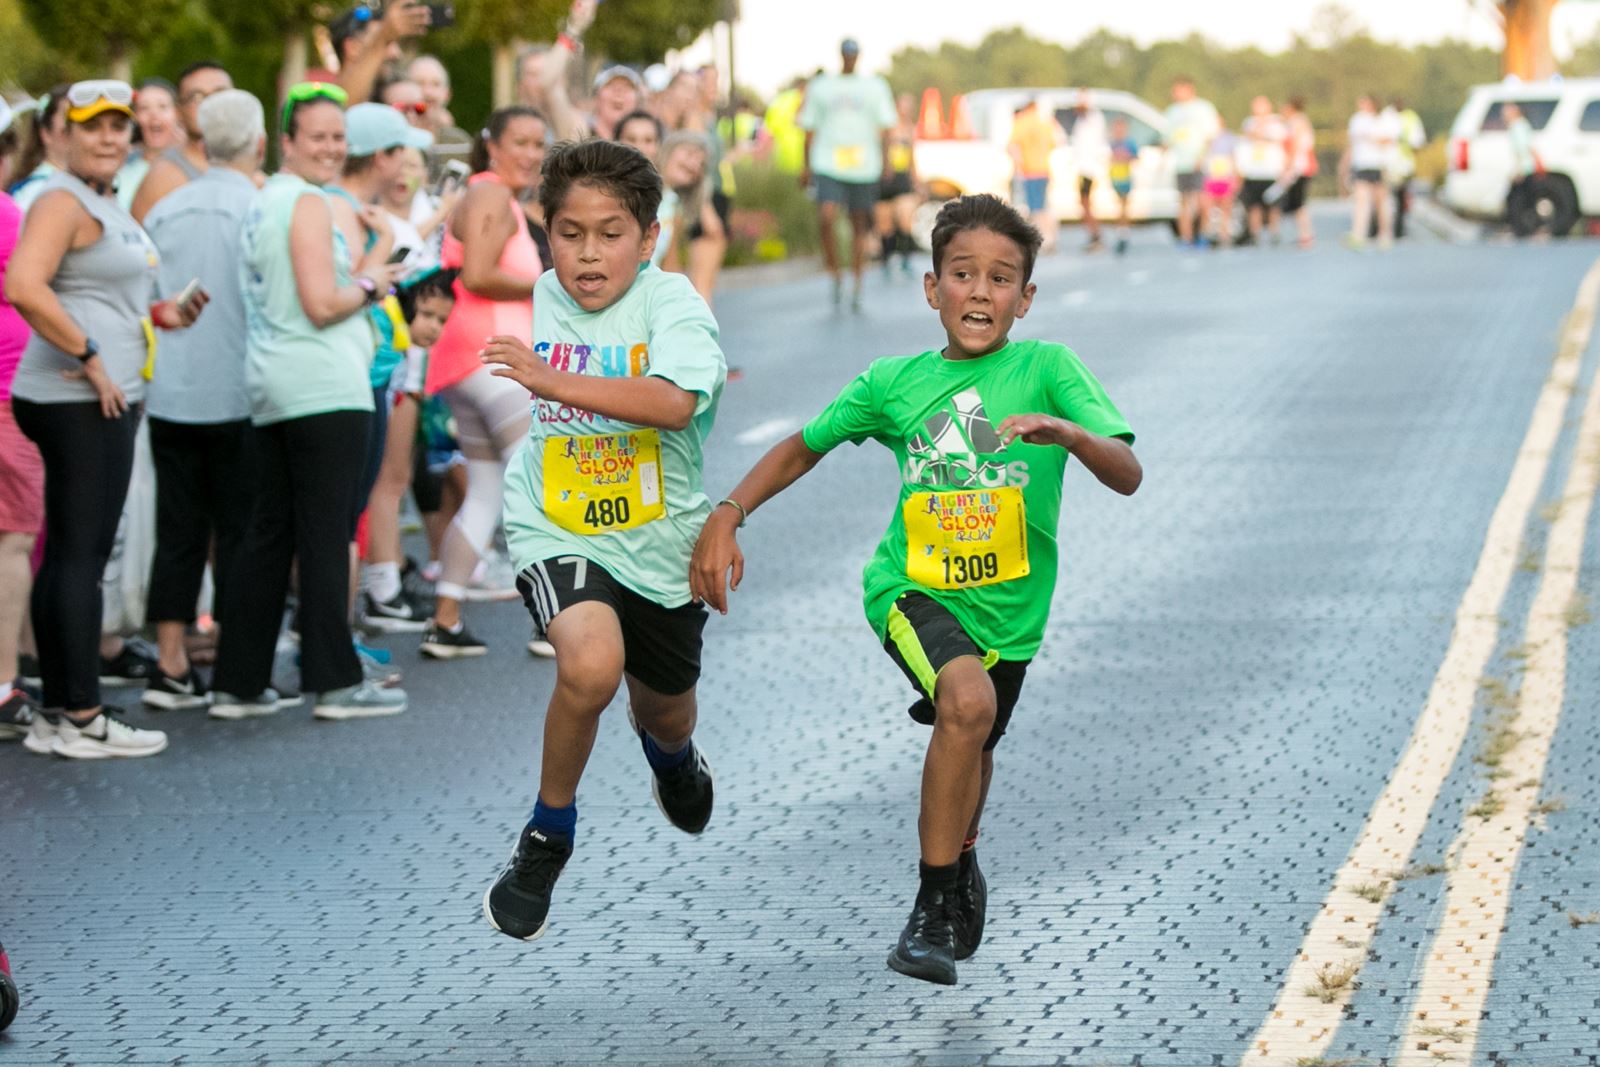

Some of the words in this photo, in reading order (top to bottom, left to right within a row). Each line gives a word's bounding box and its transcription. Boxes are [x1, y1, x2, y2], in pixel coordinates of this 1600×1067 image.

[580, 455, 637, 475] GLOW
[594, 470, 630, 485] RUN
[584, 496, 630, 528] 480
[942, 513, 998, 531] GLOW
[956, 529, 992, 542] RUN
[557, 556, 588, 590] 7
[942, 552, 998, 584] 1309
